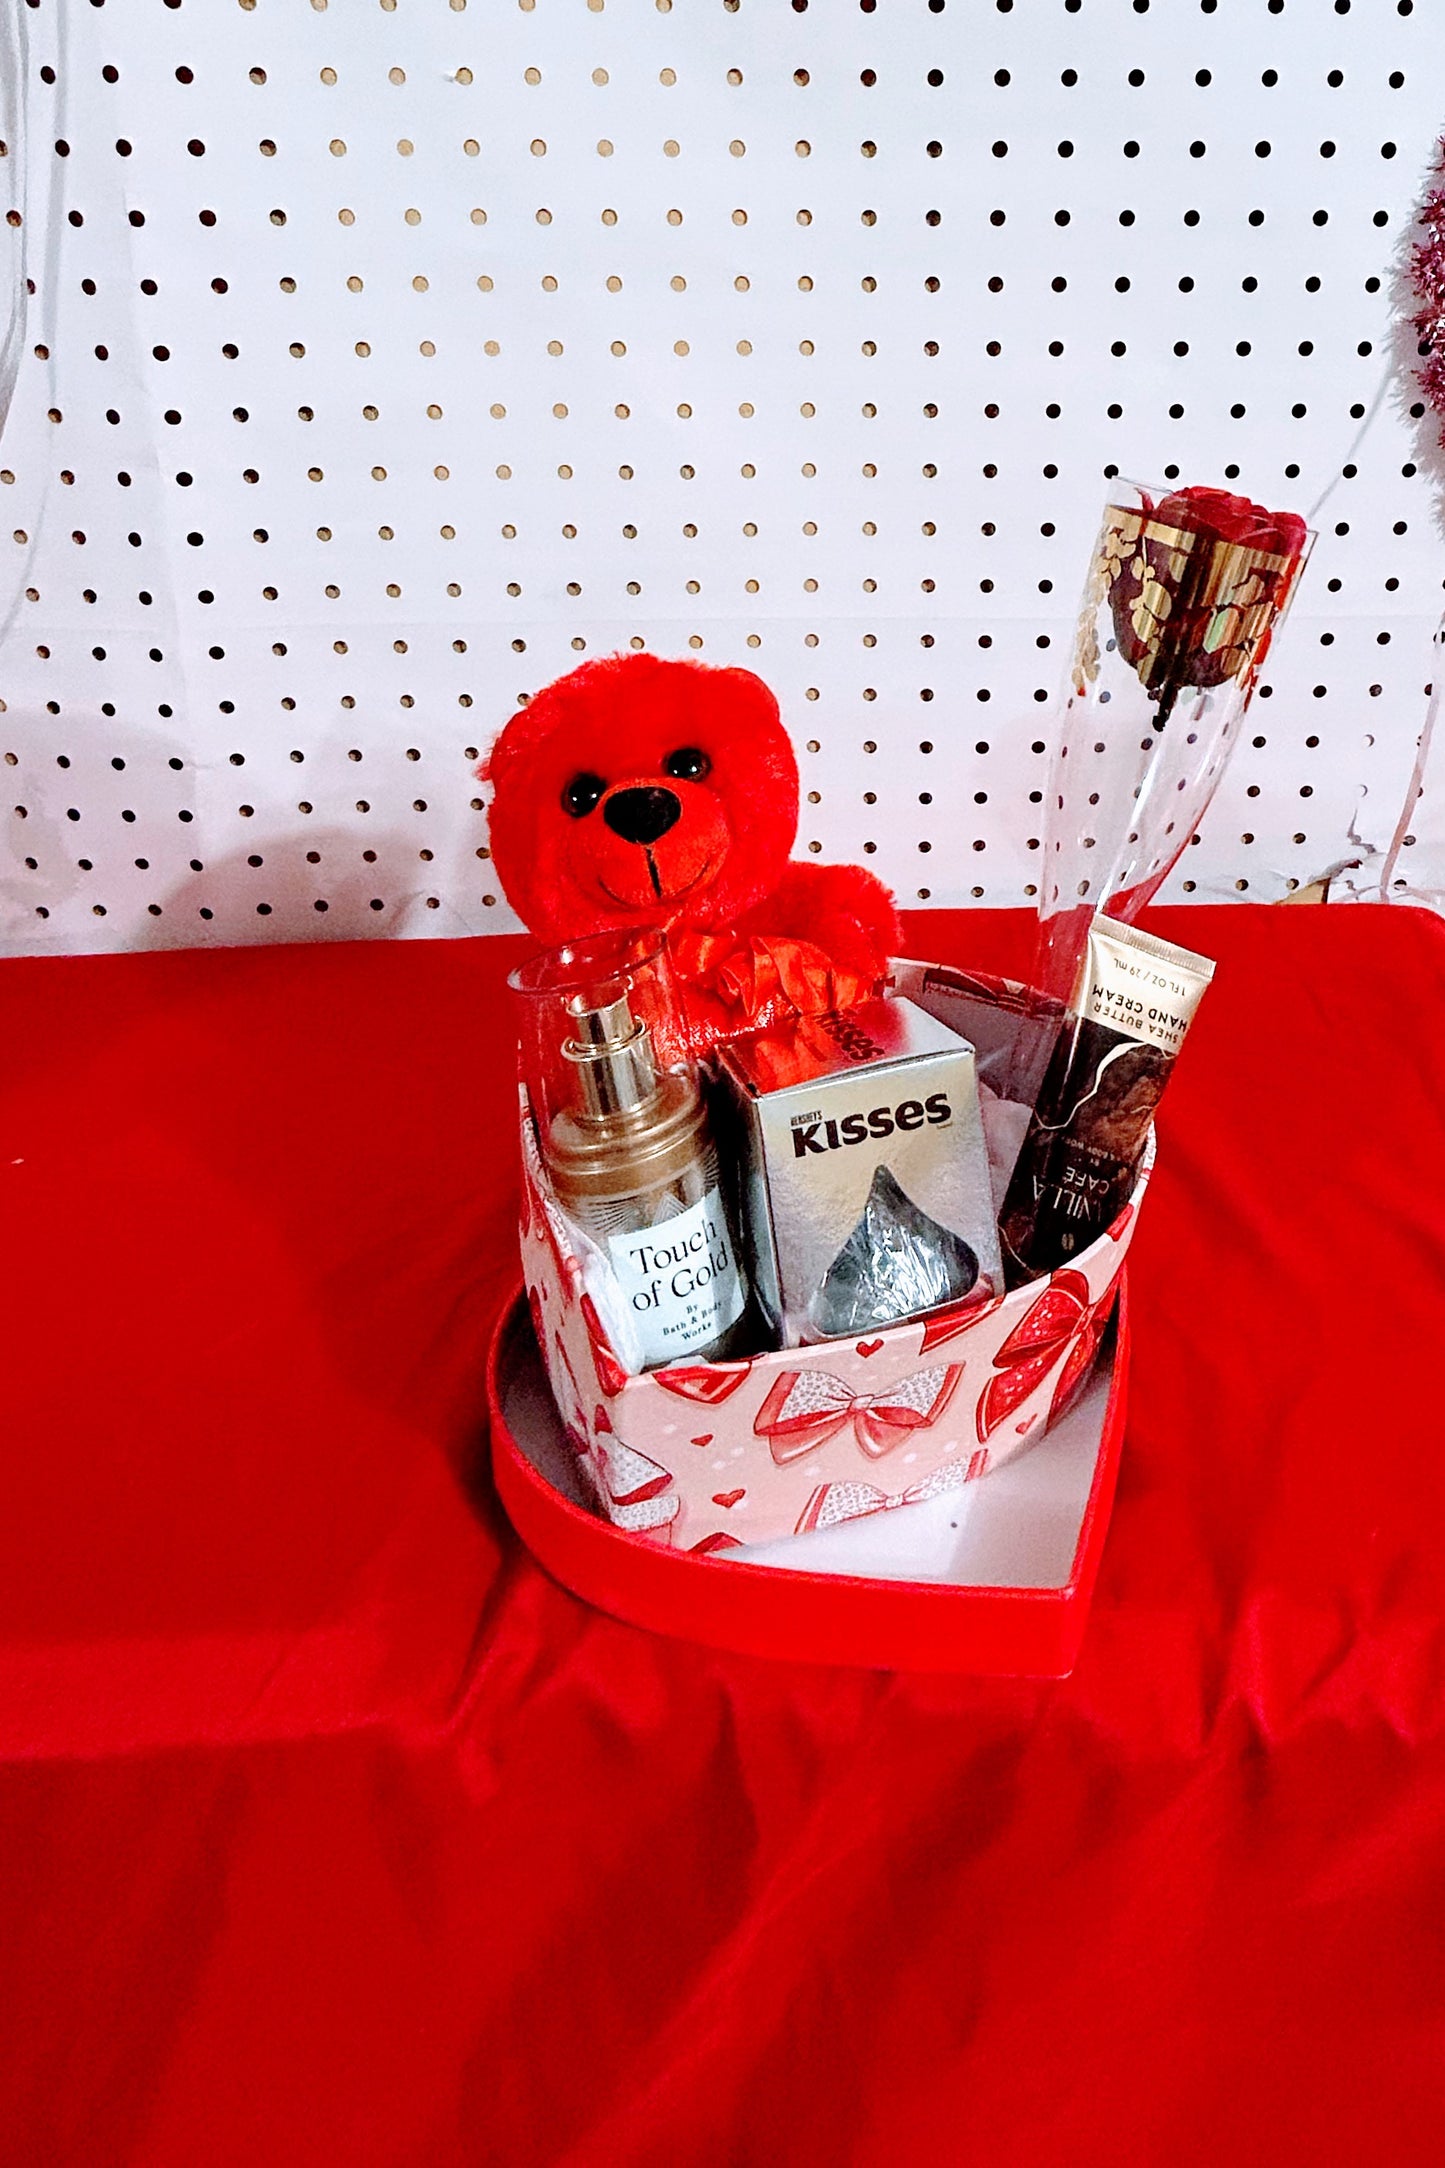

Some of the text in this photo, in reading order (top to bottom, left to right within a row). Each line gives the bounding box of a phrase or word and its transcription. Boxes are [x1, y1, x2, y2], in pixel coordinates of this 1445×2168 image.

[1092, 983, 1188, 1032] HAND CREAM
[1093, 1001, 1179, 1044] SHEA BUTTER
[1062, 1166, 1110, 1195] CAFÉ
[629, 1218, 717, 1274] Touch
[632, 1240, 729, 1311] of Gold
[662, 1302, 722, 1336] Bath & Body
[686, 1303, 699, 1315] By
[681, 1321, 712, 1341] Works
